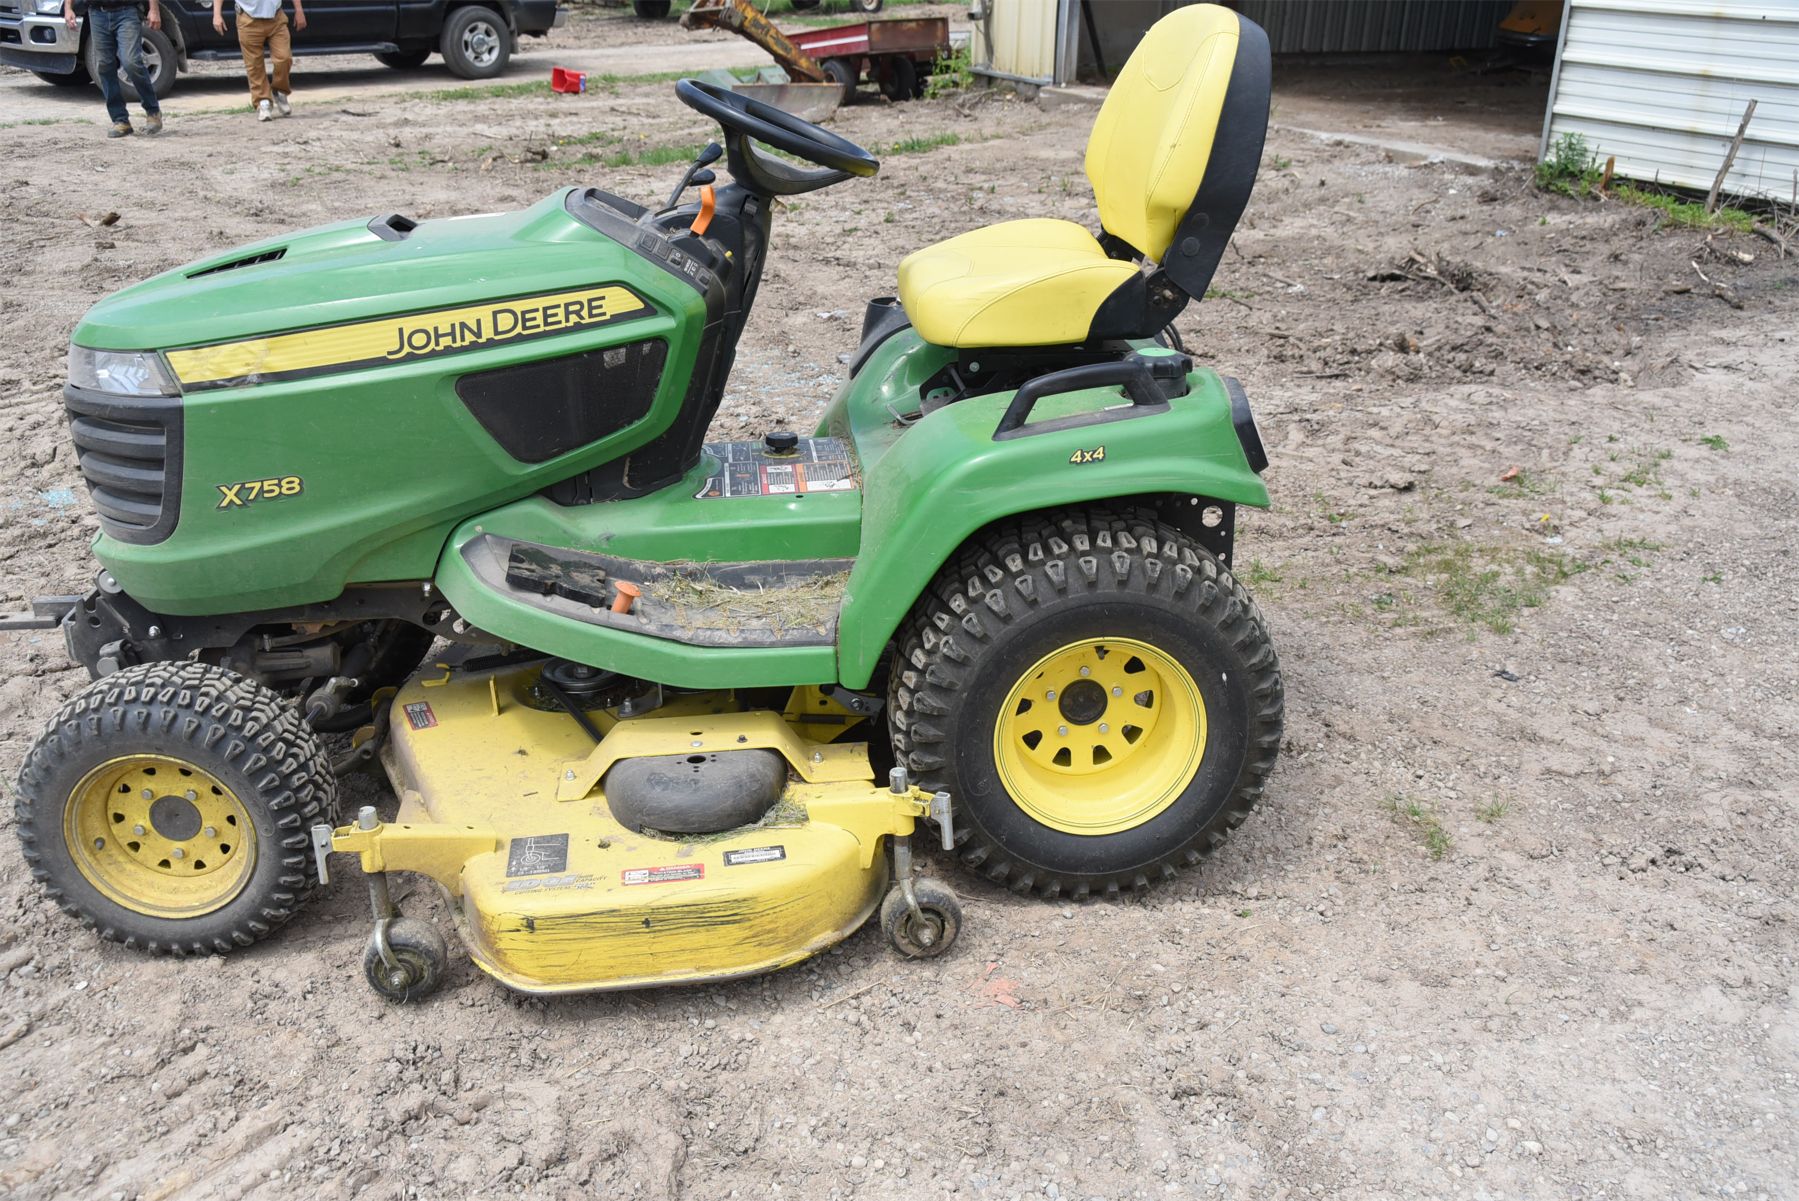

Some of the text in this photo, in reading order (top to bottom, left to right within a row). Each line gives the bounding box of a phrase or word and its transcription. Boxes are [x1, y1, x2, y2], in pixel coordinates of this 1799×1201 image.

[385, 295, 607, 357] JOHN DEERE
[1069, 446, 1105, 465] 4x4
[217, 476, 302, 508] X758
